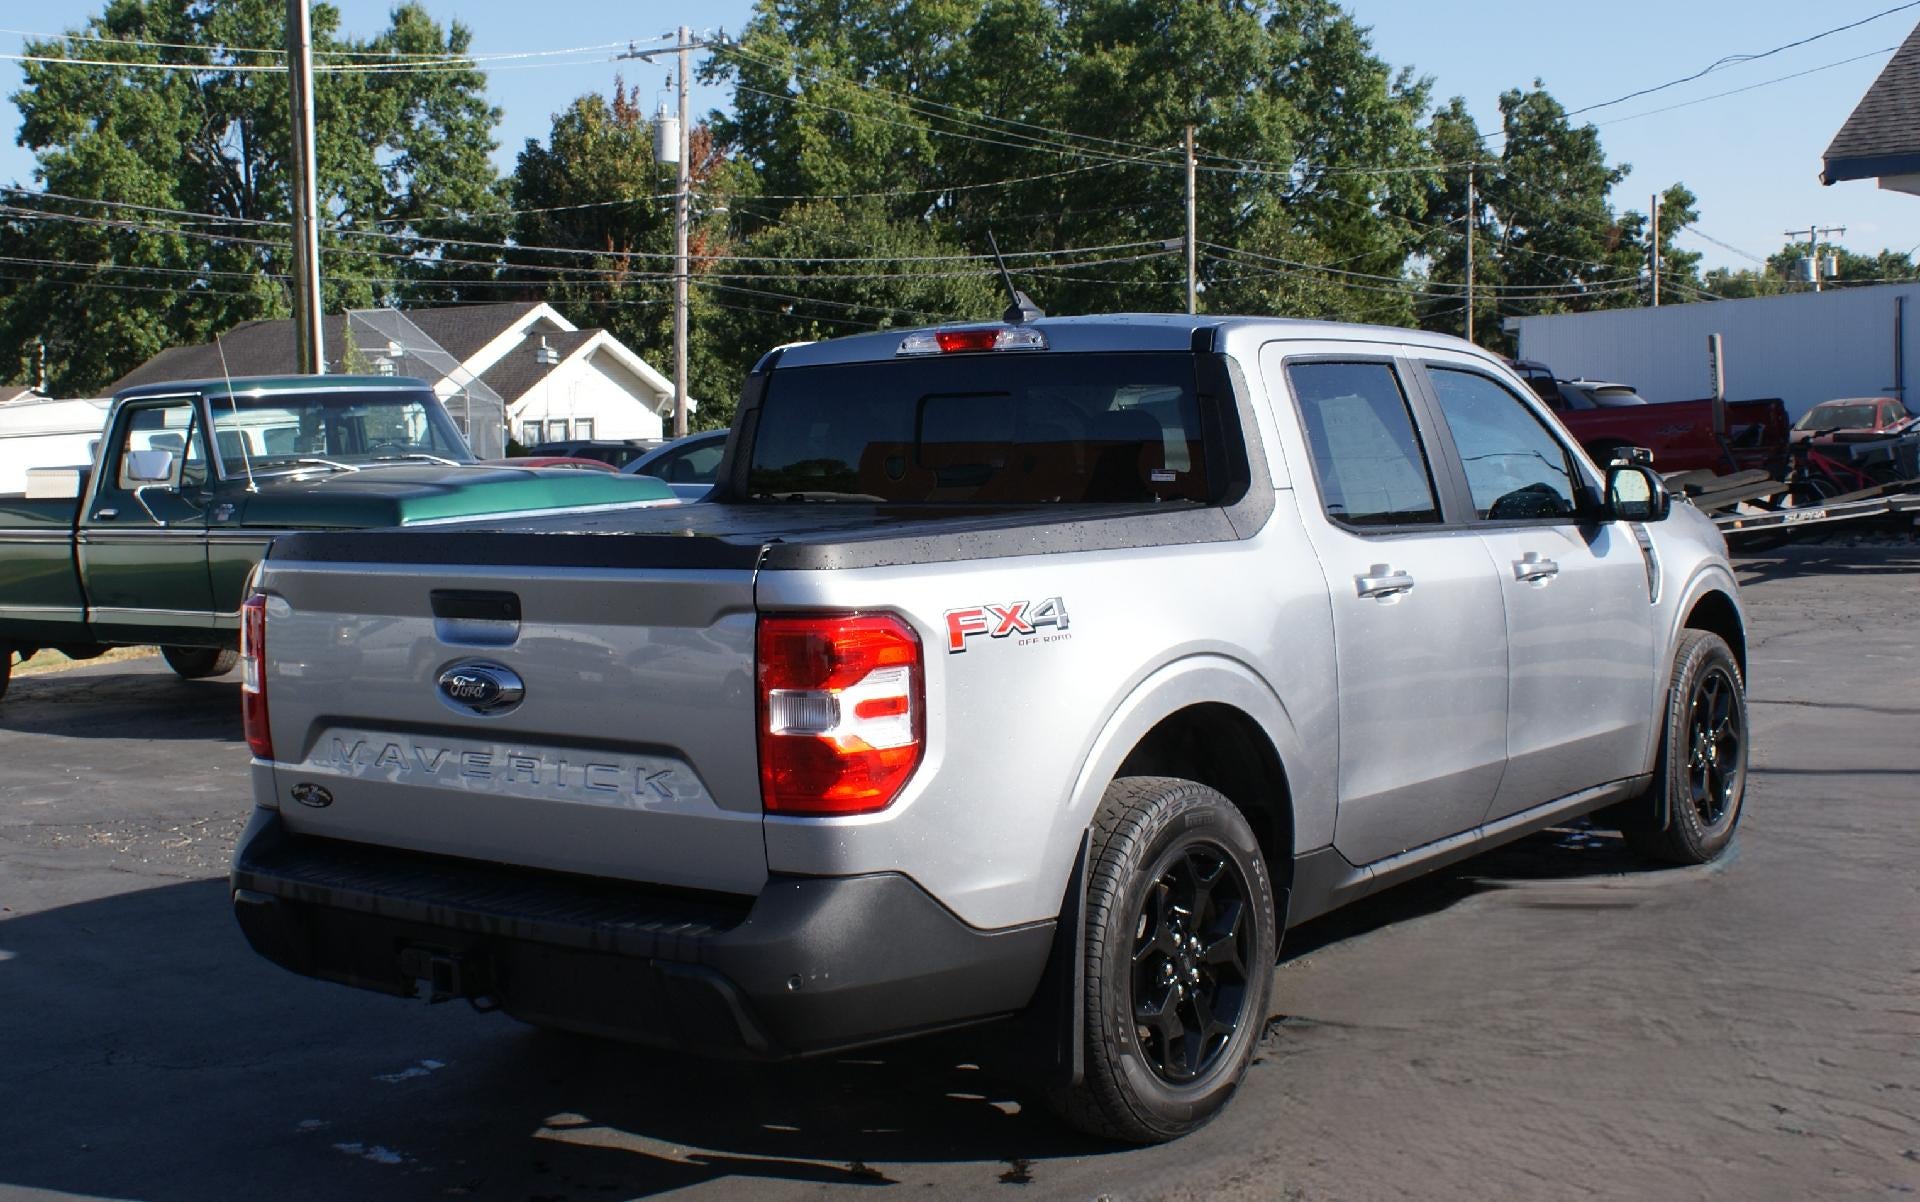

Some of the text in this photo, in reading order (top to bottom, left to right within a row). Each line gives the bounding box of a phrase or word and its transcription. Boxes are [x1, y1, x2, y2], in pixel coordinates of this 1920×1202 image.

[943, 596, 1070, 654] FX4
[1018, 633, 1072, 646] OFF ROAD
[450, 675, 486, 699] Ford
[332, 737, 675, 799] MAVERICK
